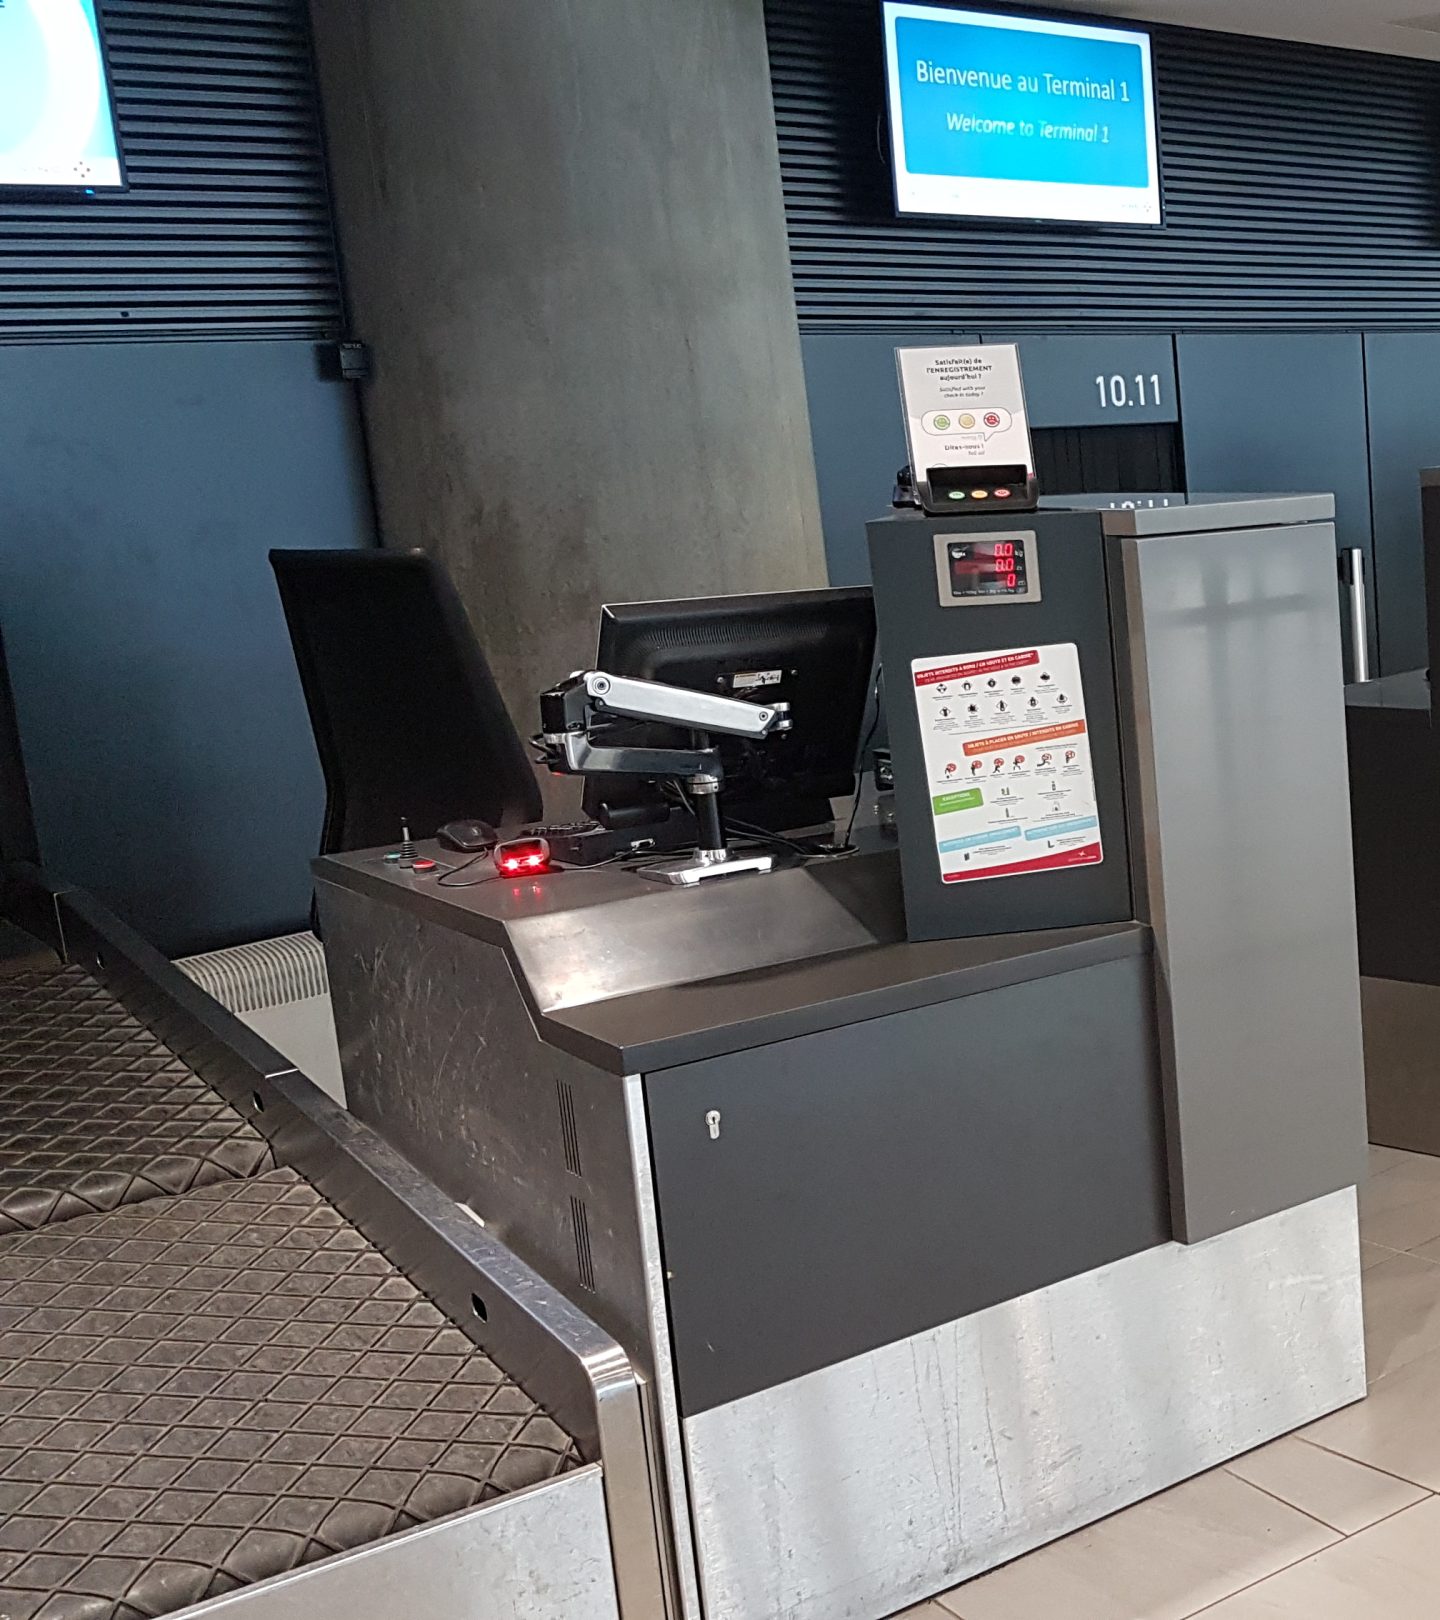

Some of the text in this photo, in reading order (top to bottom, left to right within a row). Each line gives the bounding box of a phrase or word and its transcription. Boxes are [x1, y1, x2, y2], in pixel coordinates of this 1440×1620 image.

[916, 59, 1130, 103] Bienvenue au Terminal 1
[946, 112, 1110, 144] Welcome to Terminal 1
[935, 358, 972, 366] Satisfait(e)
[939, 373, 977, 381] aujourd'hui
[1095, 374, 1161, 408] 10.11
[994, 543, 1013, 556] 0.0
[995, 558, 1014, 572] 0.0
[1007, 573, 1016, 587] 0
